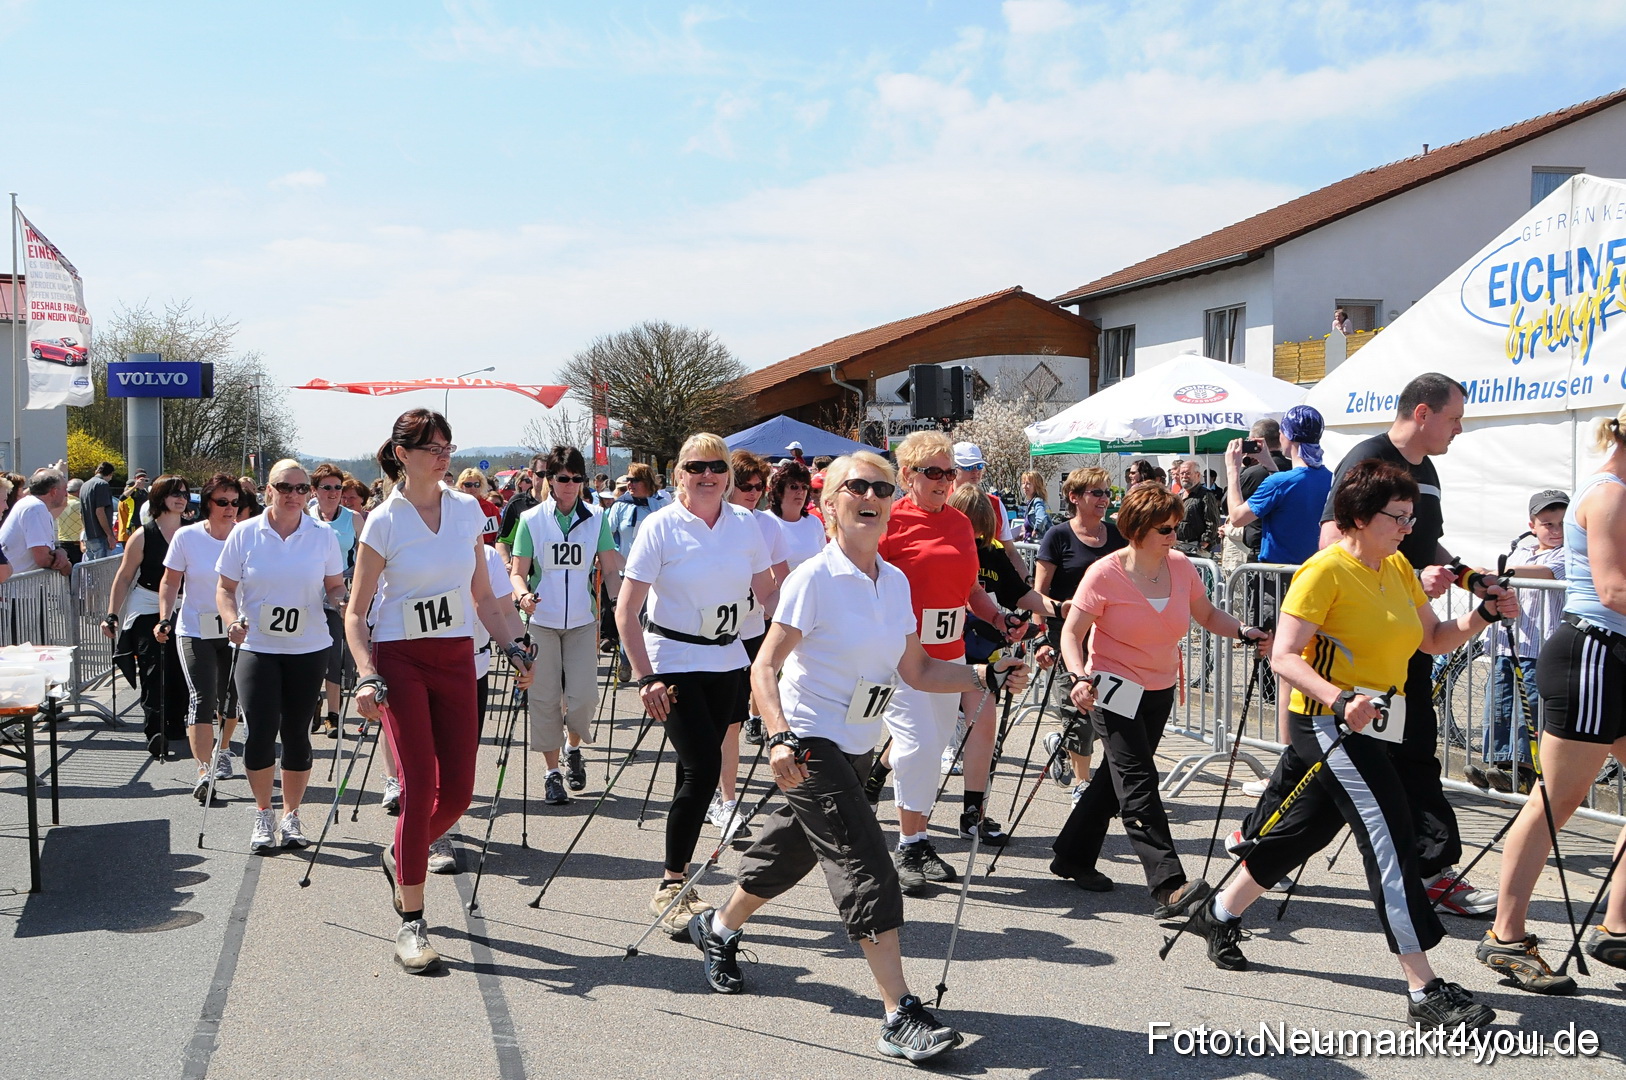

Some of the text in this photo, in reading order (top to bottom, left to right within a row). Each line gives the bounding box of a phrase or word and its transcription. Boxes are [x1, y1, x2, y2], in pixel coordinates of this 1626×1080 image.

[31, 301, 62, 311] DESHALB
[31, 311, 46, 320] DEN
[47, 312, 67, 322] NEUEN
[116, 372, 188, 385] VOLVO
[1460, 373, 1593, 405] Mühlhausen
[1163, 412, 1245, 428] ERDINGER
[551, 543, 582, 566] 120
[269, 606, 300, 633] 20
[413, 595, 453, 633] 114
[714, 602, 738, 636] 21
[935, 610, 958, 640] 51
[1102, 675, 1124, 706] 7
